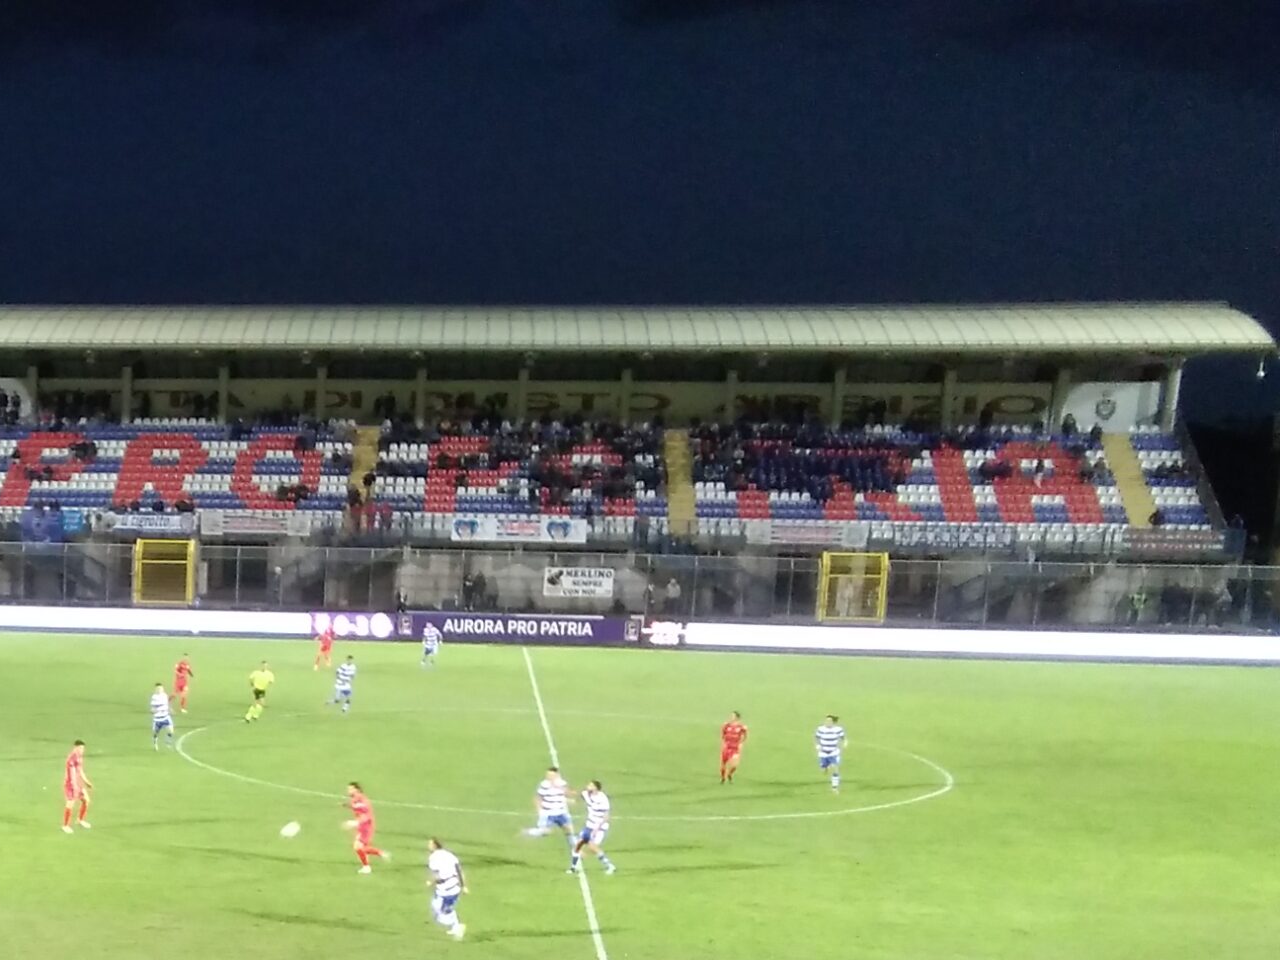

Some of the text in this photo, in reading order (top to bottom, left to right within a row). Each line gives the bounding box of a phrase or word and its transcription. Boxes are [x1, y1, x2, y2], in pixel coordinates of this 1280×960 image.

[566, 569, 612, 578] MERLINO
[443, 618, 593, 637] AURORA PRO PATRIA
